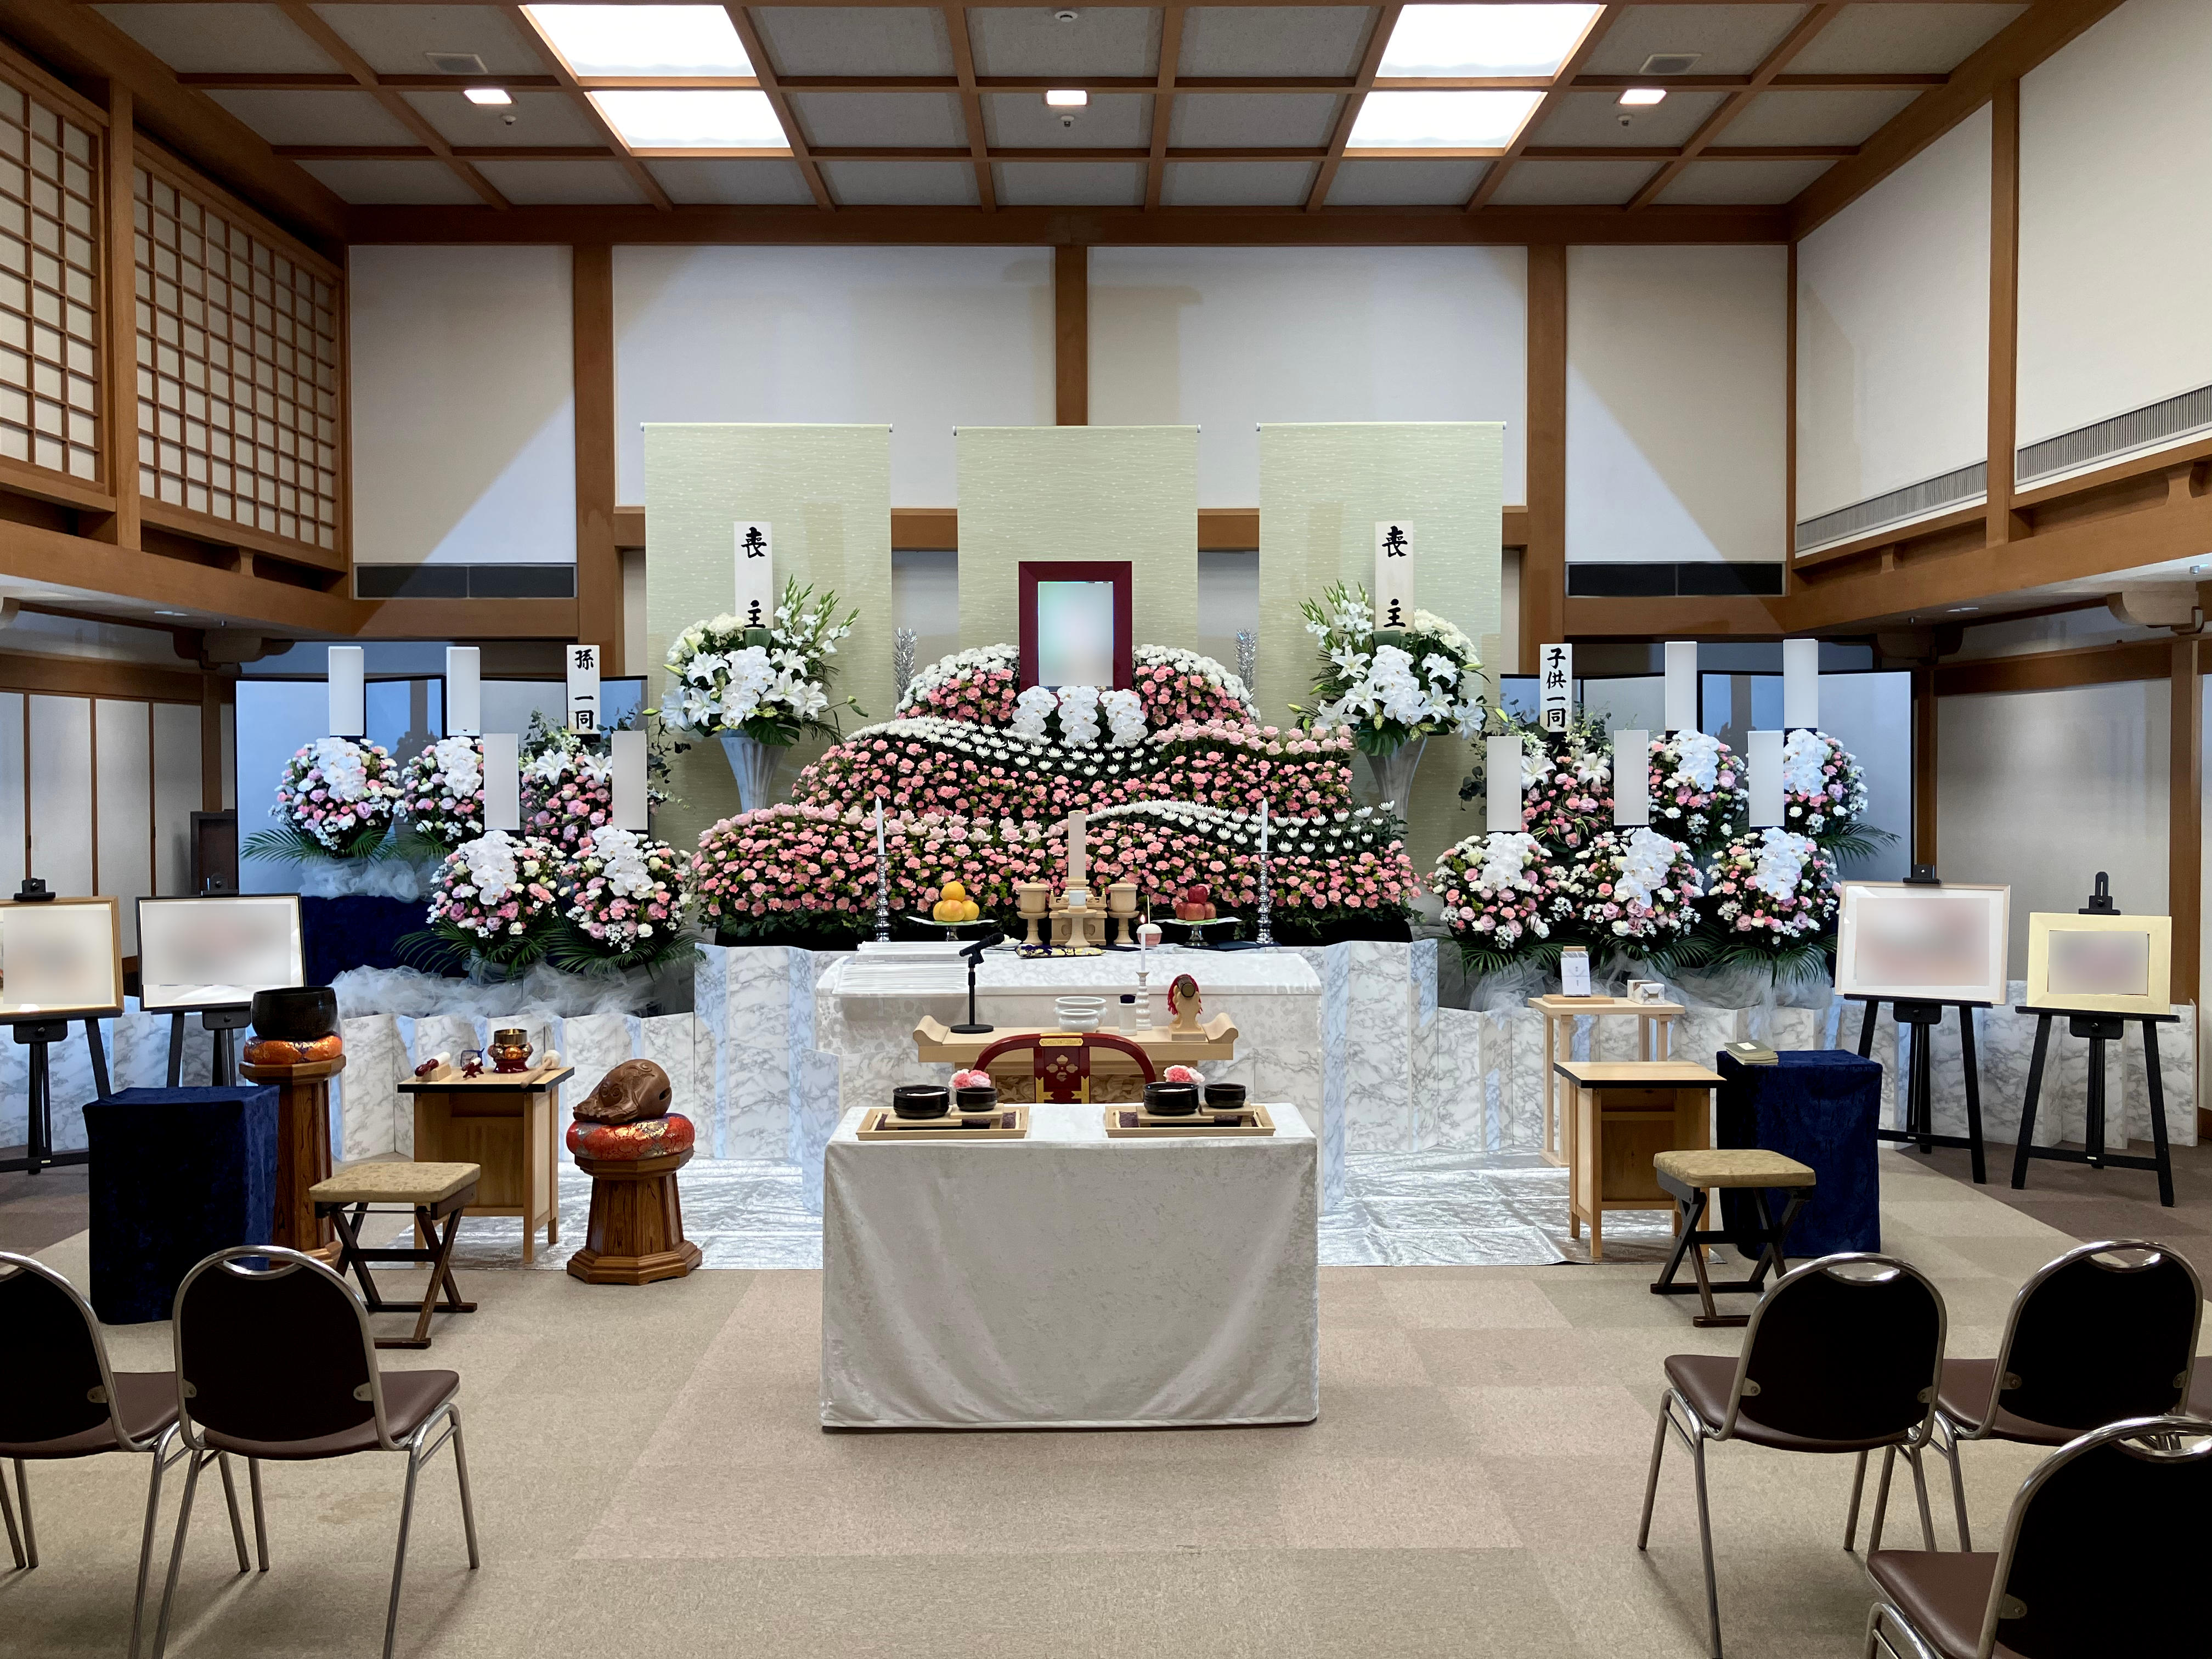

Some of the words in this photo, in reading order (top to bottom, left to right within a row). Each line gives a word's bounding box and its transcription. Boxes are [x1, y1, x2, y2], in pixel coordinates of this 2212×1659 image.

[741, 526, 767, 628] 喪主
[1381, 525, 1408, 628] 喪主
[574, 648, 594, 730] 孫一同
[1546, 647, 1567, 728] 子供一同
